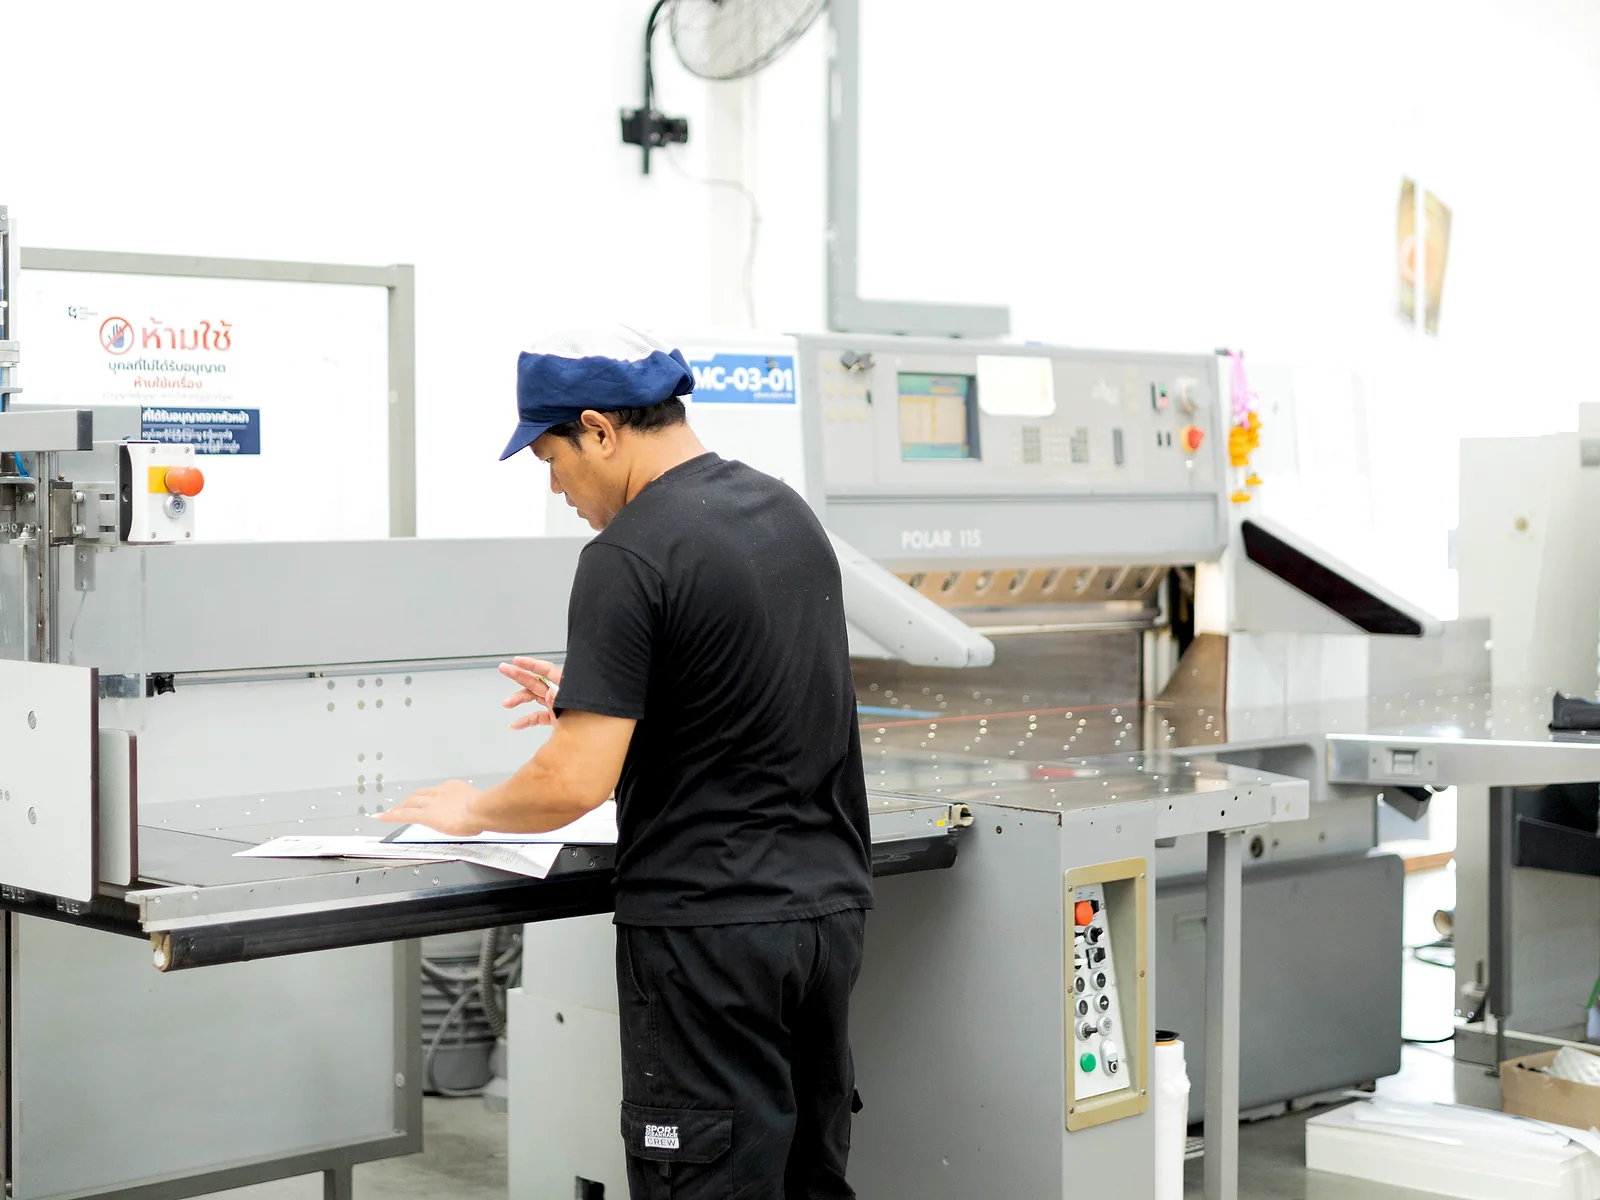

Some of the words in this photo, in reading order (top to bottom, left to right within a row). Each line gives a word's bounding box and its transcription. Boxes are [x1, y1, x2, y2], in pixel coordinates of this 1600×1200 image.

[141, 317, 232, 351] ห้ามใช้
[692, 366, 793, 391] MC-03-01
[901, 530, 953, 549] POLAR
[959, 529, 982, 548] 115
[645, 1124, 679, 1135] SPORT
[647, 1137, 677, 1147] CREW
